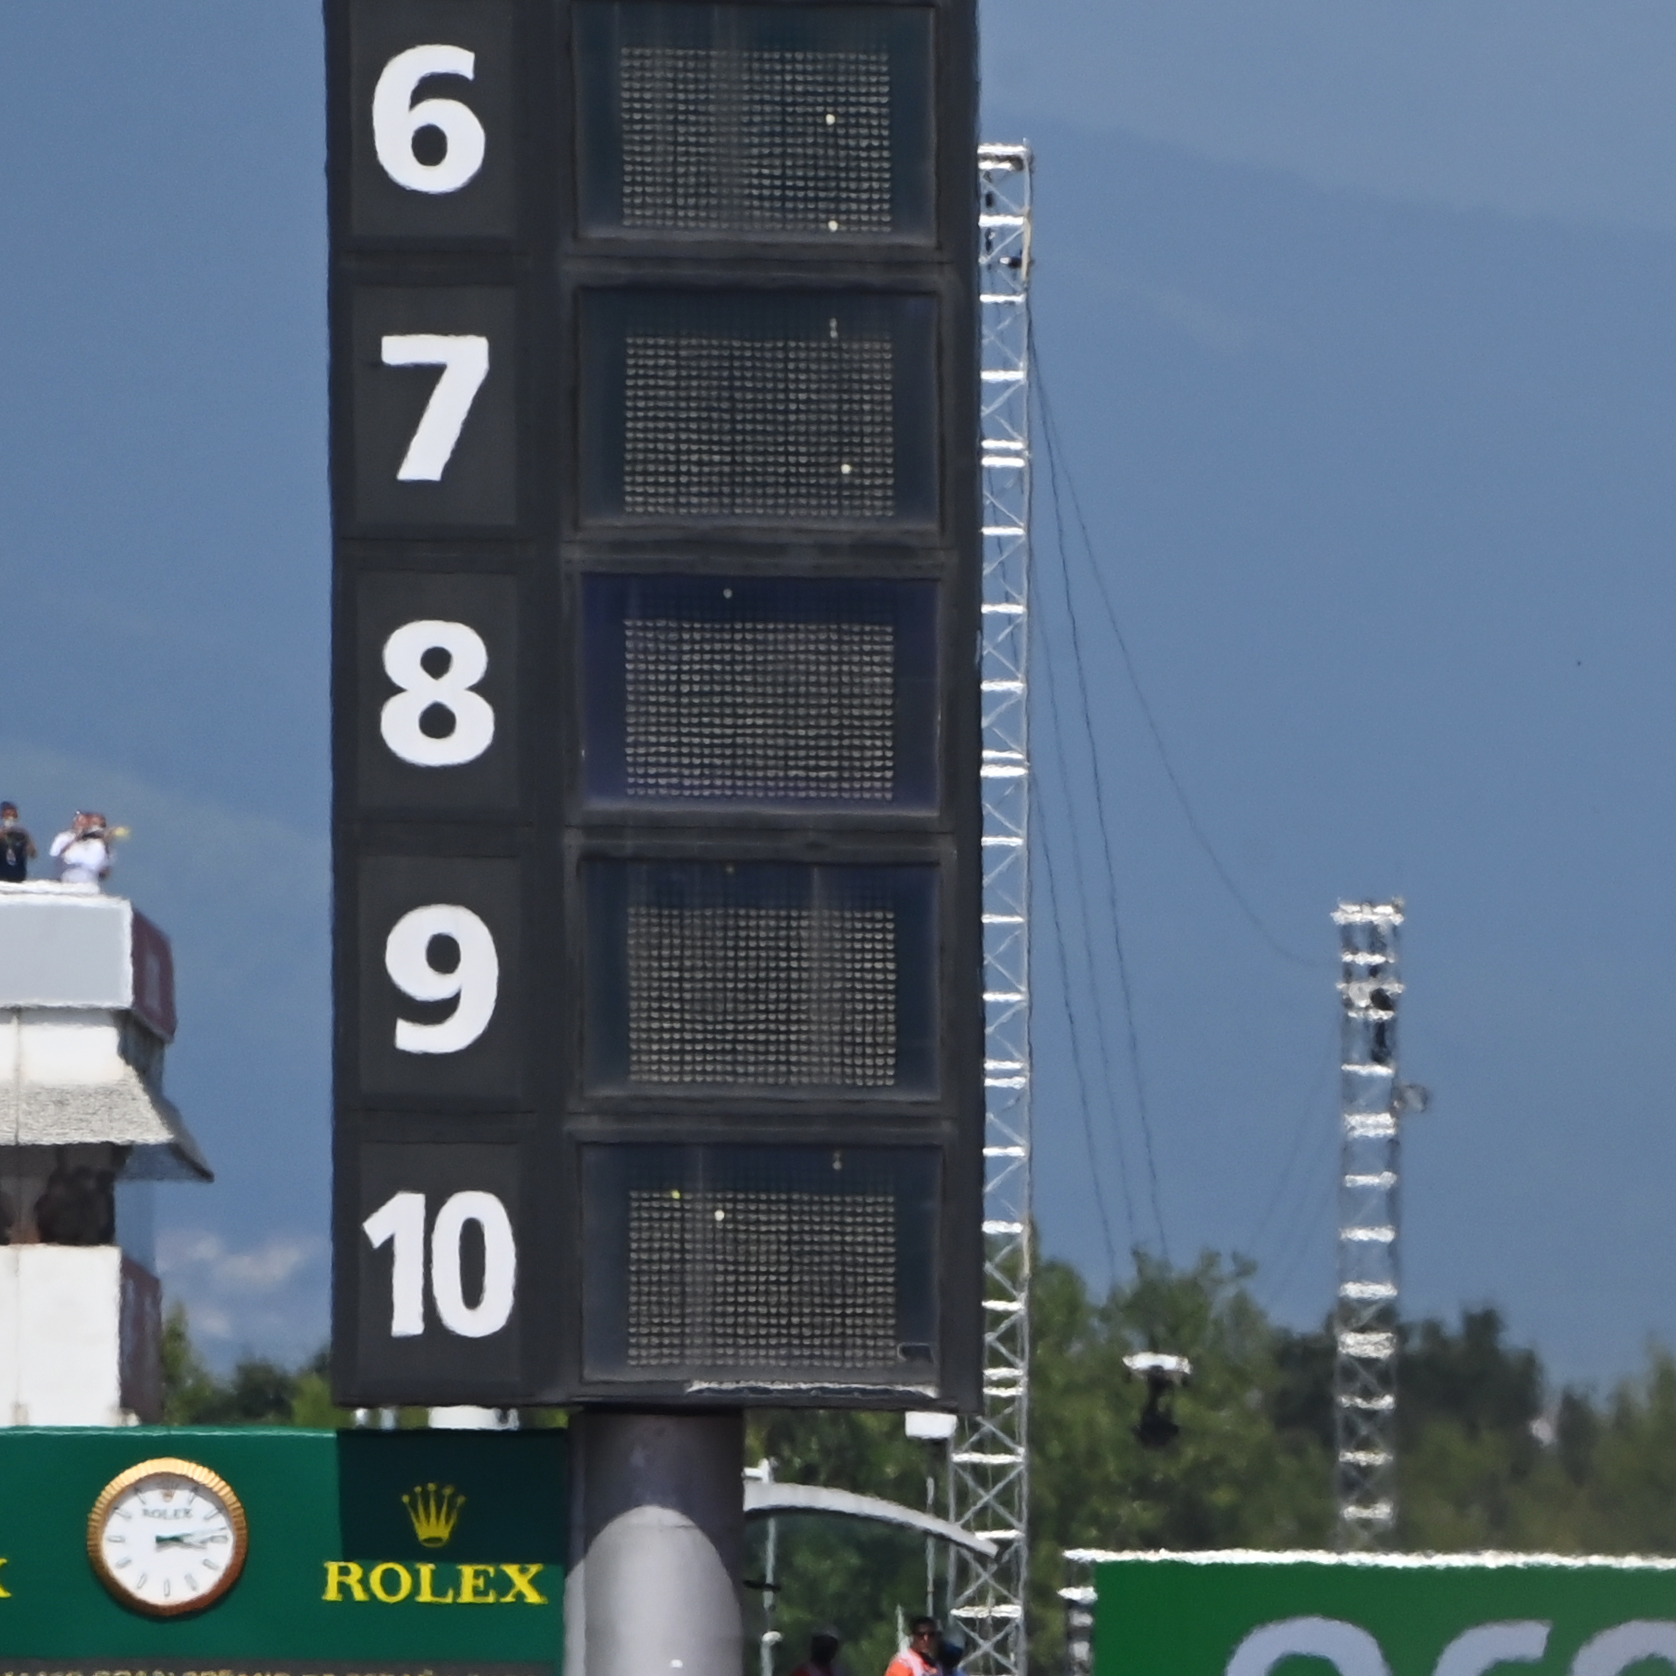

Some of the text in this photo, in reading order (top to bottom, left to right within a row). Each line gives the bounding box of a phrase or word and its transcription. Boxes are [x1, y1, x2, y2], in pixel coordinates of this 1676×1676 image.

[373, 44, 485, 194] 6
[381, 333, 489, 481] 7
[381, 619, 495, 767] 8
[385, 903, 499, 1054] 9
[362, 1190, 517, 1338] 10
[323, 1561, 548, 1604] ROLEX
